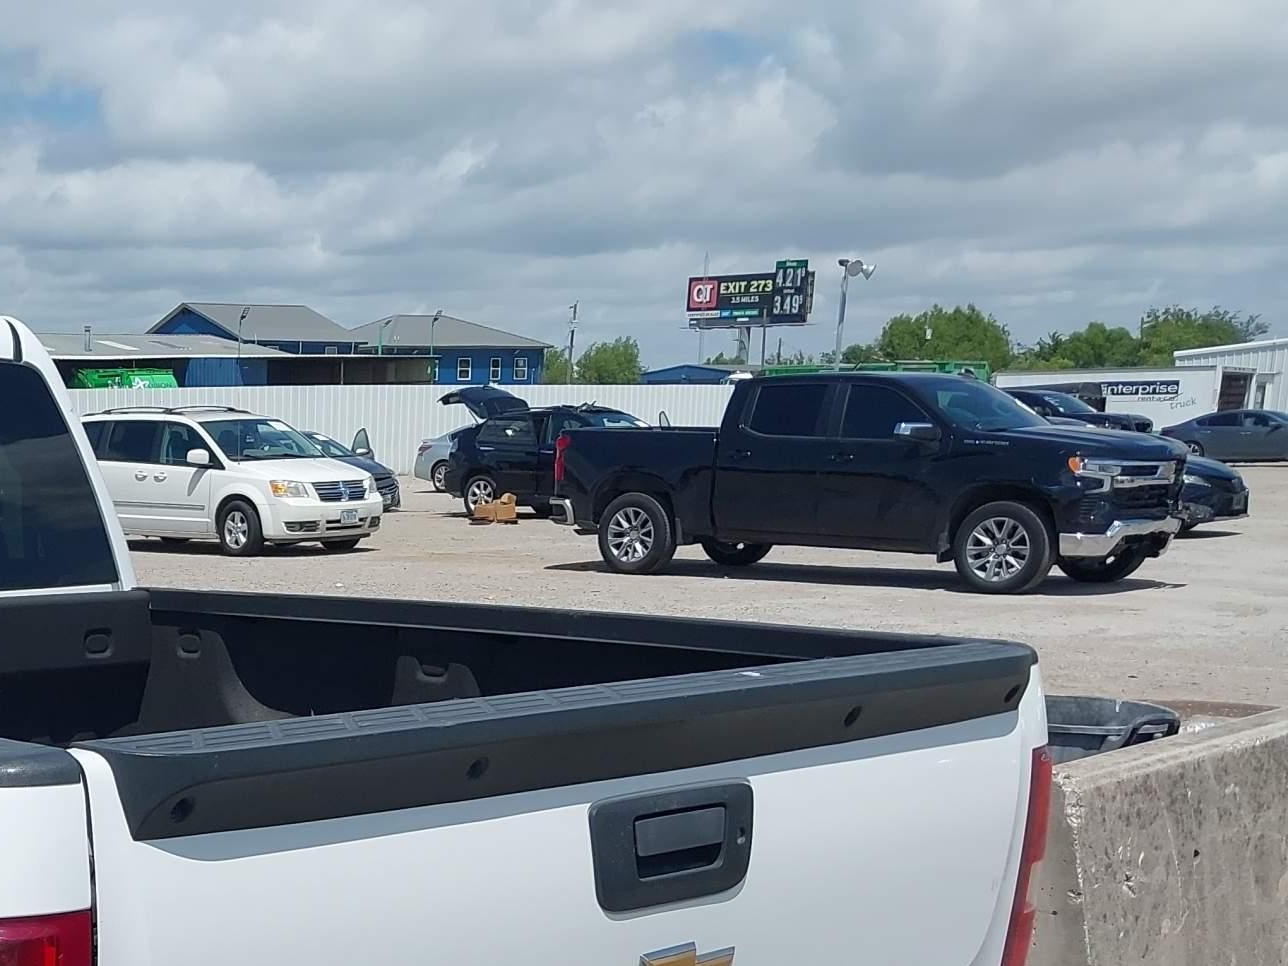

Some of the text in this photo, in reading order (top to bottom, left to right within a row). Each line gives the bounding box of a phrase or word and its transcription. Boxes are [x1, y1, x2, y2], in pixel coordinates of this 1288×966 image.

[693, 284, 713, 304] QT
[720, 282, 746, 294] EXIT
[750, 280, 773, 292] 273
[1169, 397, 1198, 410] truck
